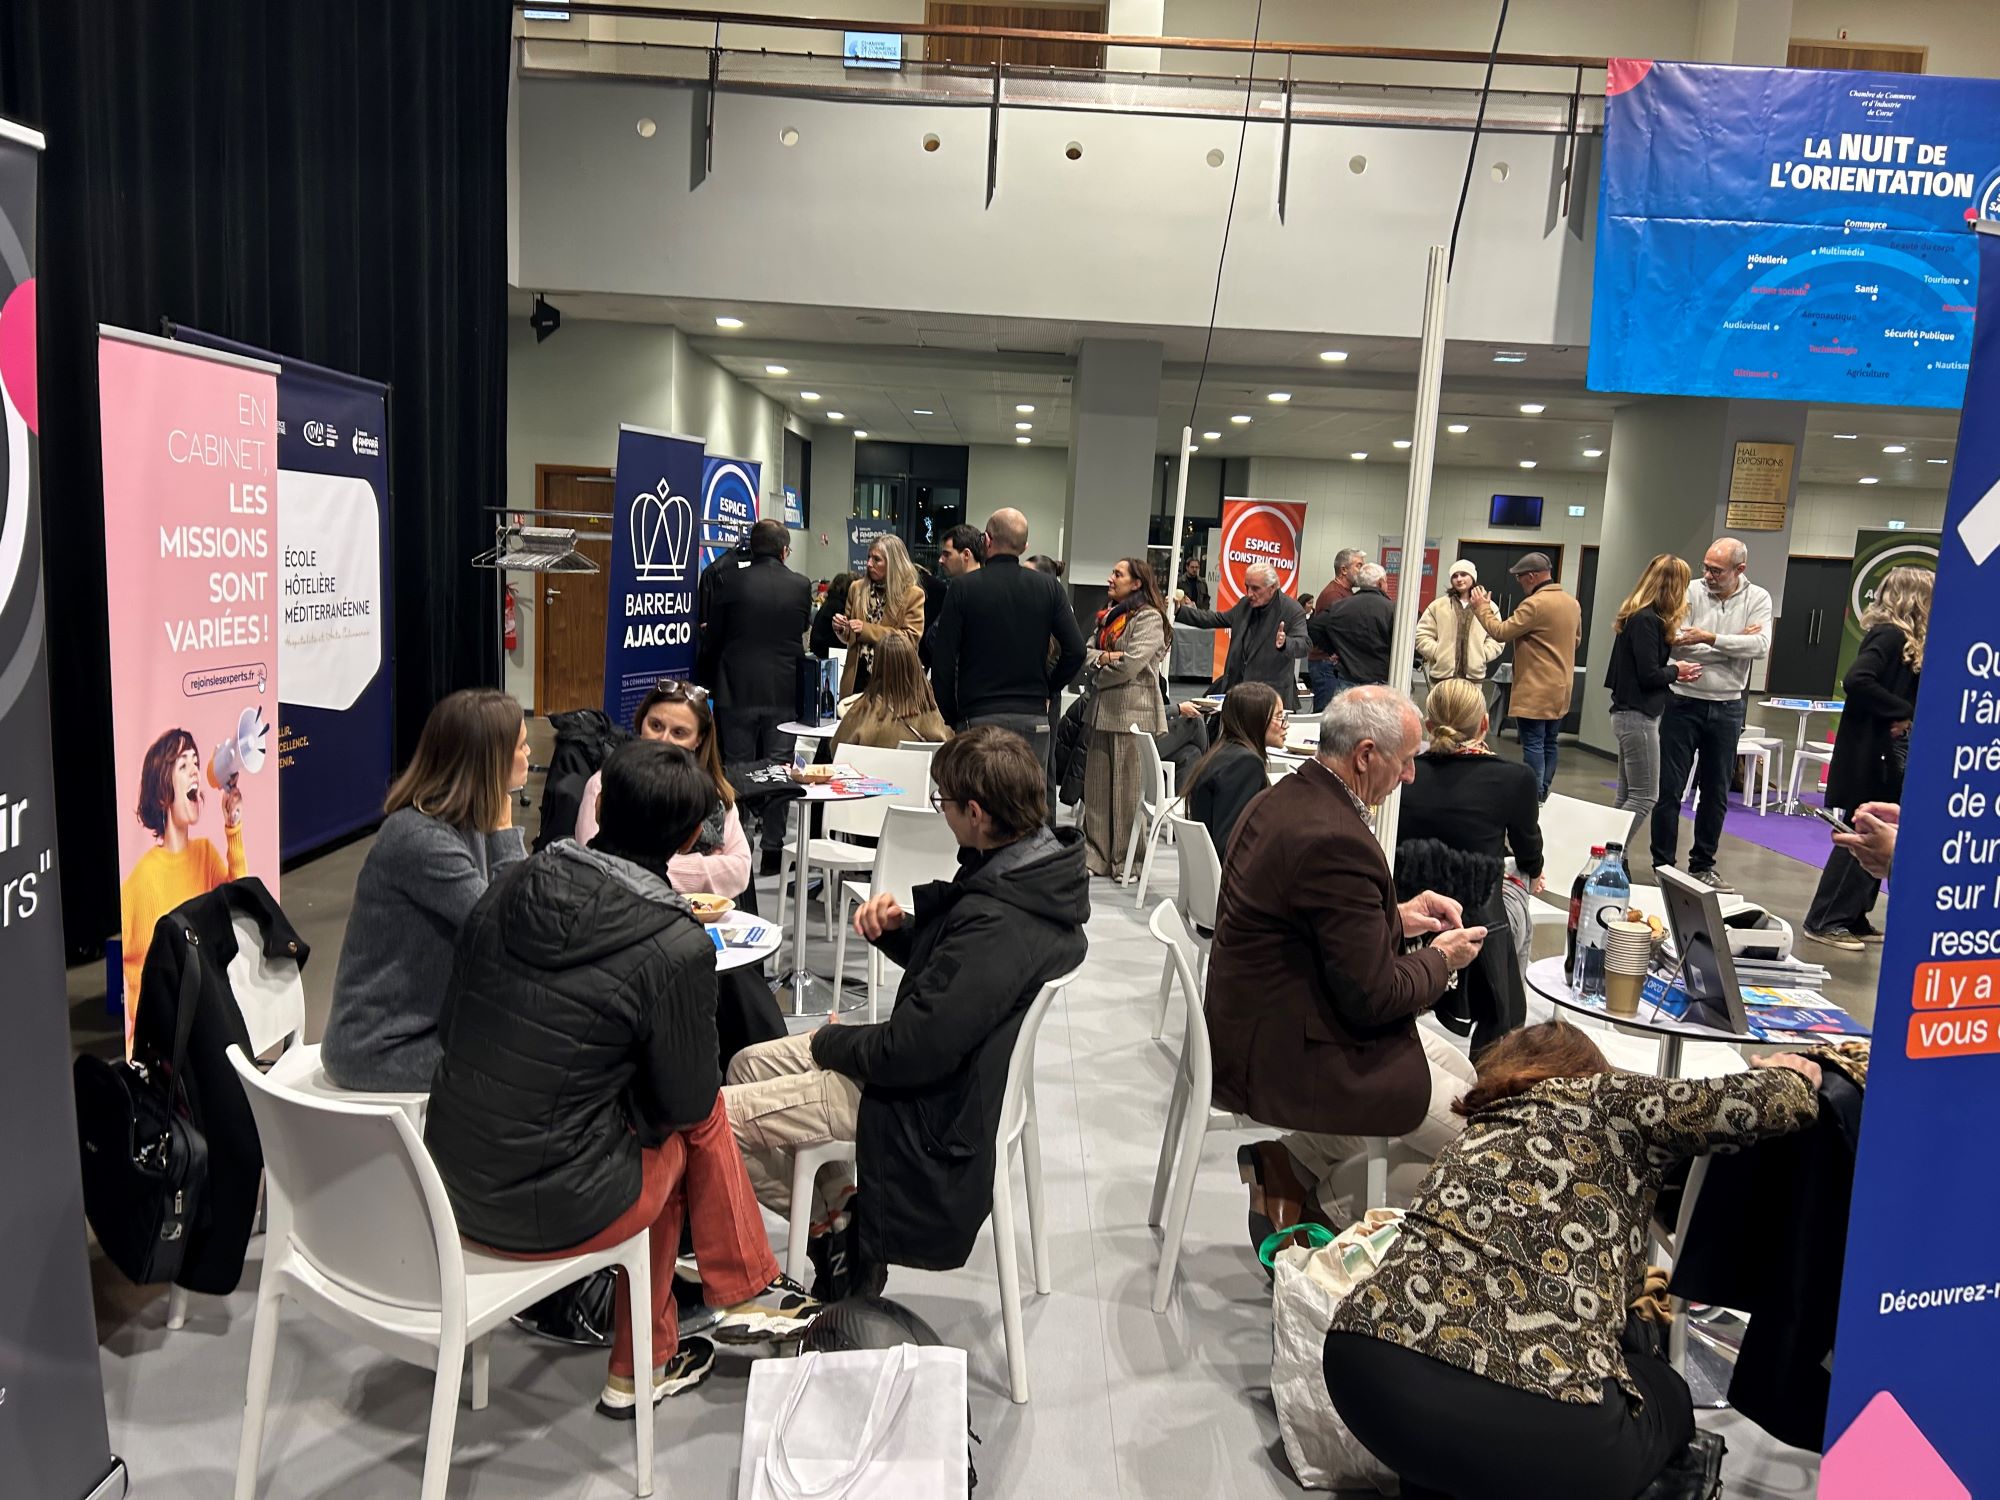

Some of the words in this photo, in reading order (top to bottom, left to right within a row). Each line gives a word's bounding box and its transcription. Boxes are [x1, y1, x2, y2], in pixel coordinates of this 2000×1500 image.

[1849, 89, 1875, 99] Chambre
[1885, 91, 1916, 101] Commerce
[1875, 109, 1894, 117] Corse
[1804, 138, 1832, 159] LA
[1839, 133, 1914, 163] NUIT
[1917, 144, 1948, 166] DE
[1770, 161, 1974, 198] L'ORIENTATION
[1845, 219, 1887, 231] Commerce
[1748, 254, 1788, 265] Hôtellerie
[1819, 247, 1865, 257] Multimédia
[1855, 284, 1879, 294] Santé
[1924, 275, 1960, 285] Tourisme
[1723, 321, 1770, 331] Audiovisuel
[1885, 329, 1919, 339] Sécurité
[1919, 331, 1955, 342] Publique
[1847, 369, 1890, 380] Agriculture
[239, 392, 266, 428] EN
[168, 429, 268, 477] CABINET,
[1737, 448, 1757, 457] HALL
[1737, 457, 1784, 467] EXPOSITIONS
[229, 482, 268, 515] LES
[720, 497, 747, 517] ESPACE
[159, 525, 268, 559] MISSIONS
[1245, 537, 1281, 554] ESPACE
[284, 545, 317, 567] ÉCOLE
[1229, 550, 1294, 570] CONSTRUCTION
[209, 571, 268, 603] SONT
[285, 571, 336, 596] HÔTELIÈRE
[285, 596, 370, 624] MÉDITERRANÉENNE
[625, 592, 692, 617] BARREAU
[165, 608, 260, 653] VARIÉES
[623, 622, 691, 648] AJACCIO
[190, 670, 255, 691] rejoinslesexperts.fr
[1948, 784, 1986, 818] de
[1936, 884, 1986, 911] sur
[1924, 968, 1941, 1002] il
[1947, 976, 1968, 1009] y
[1974, 974, 1992, 999] a
[1920, 1019, 1988, 1047] vous
